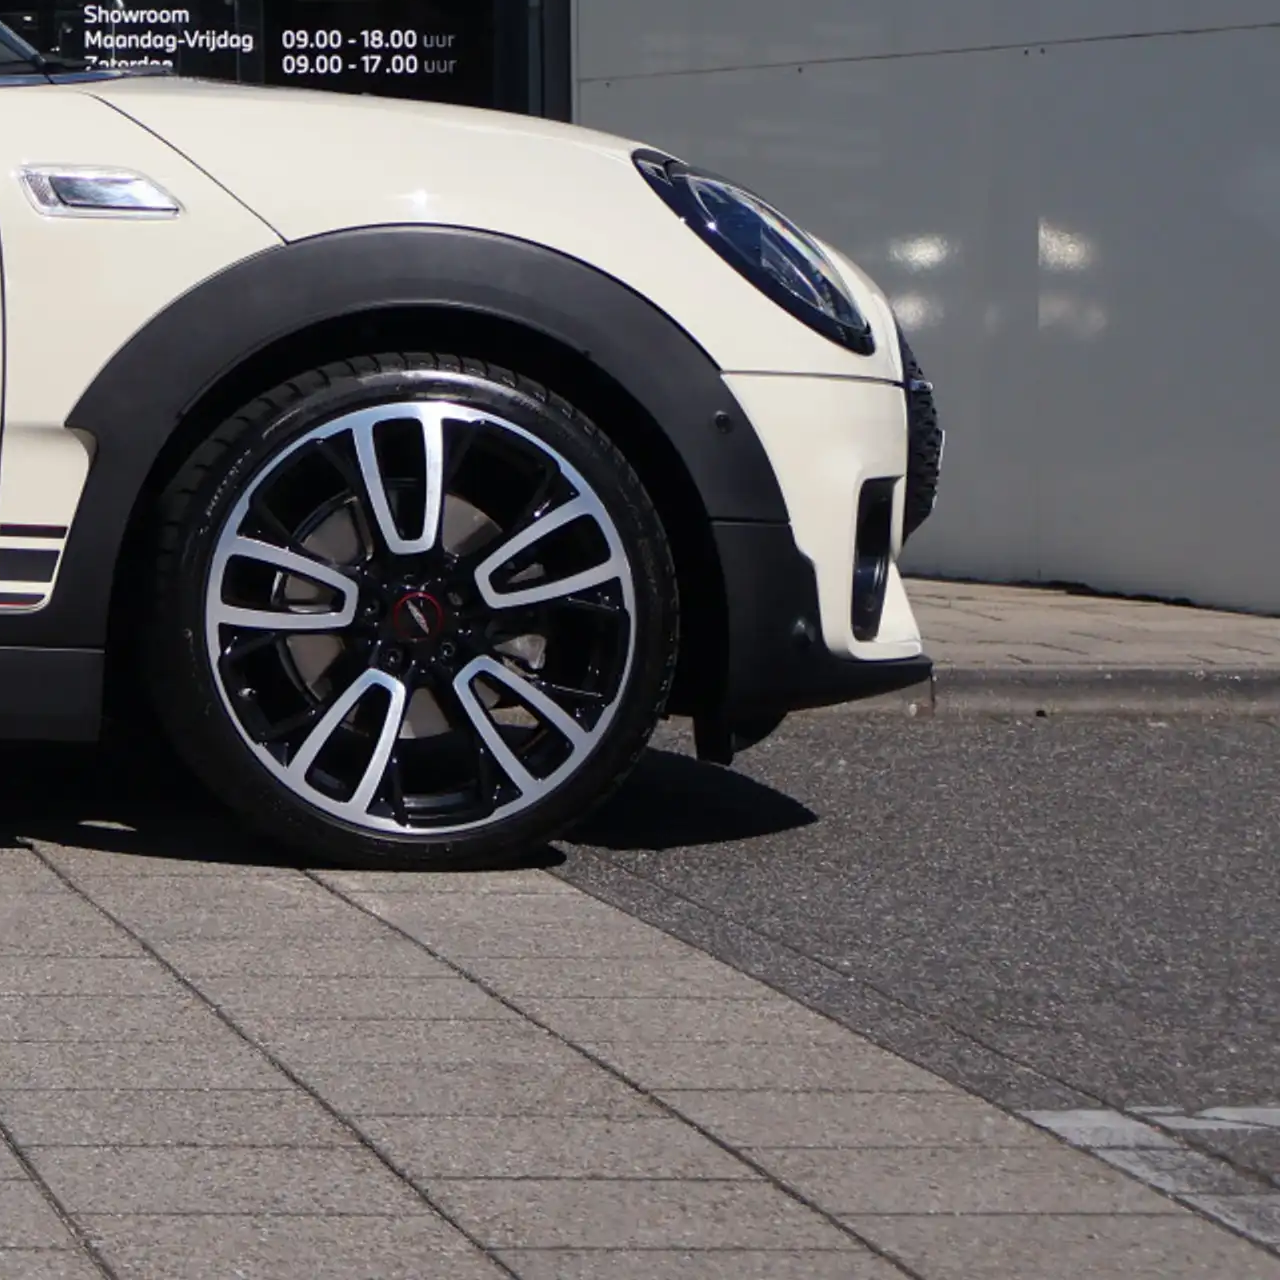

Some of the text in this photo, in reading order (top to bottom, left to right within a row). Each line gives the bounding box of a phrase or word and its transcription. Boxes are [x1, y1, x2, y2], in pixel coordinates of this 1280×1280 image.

[83, 4, 189, 24] Showroom
[84, 29, 254, 53] Maandag-Vrijdag
[282, 29, 342, 49] 09.00
[360, 29, 417, 49] 18.00
[422, 34, 456, 49] uur
[282, 54, 342, 74] 09.00
[423, 59, 458, 74] uur
